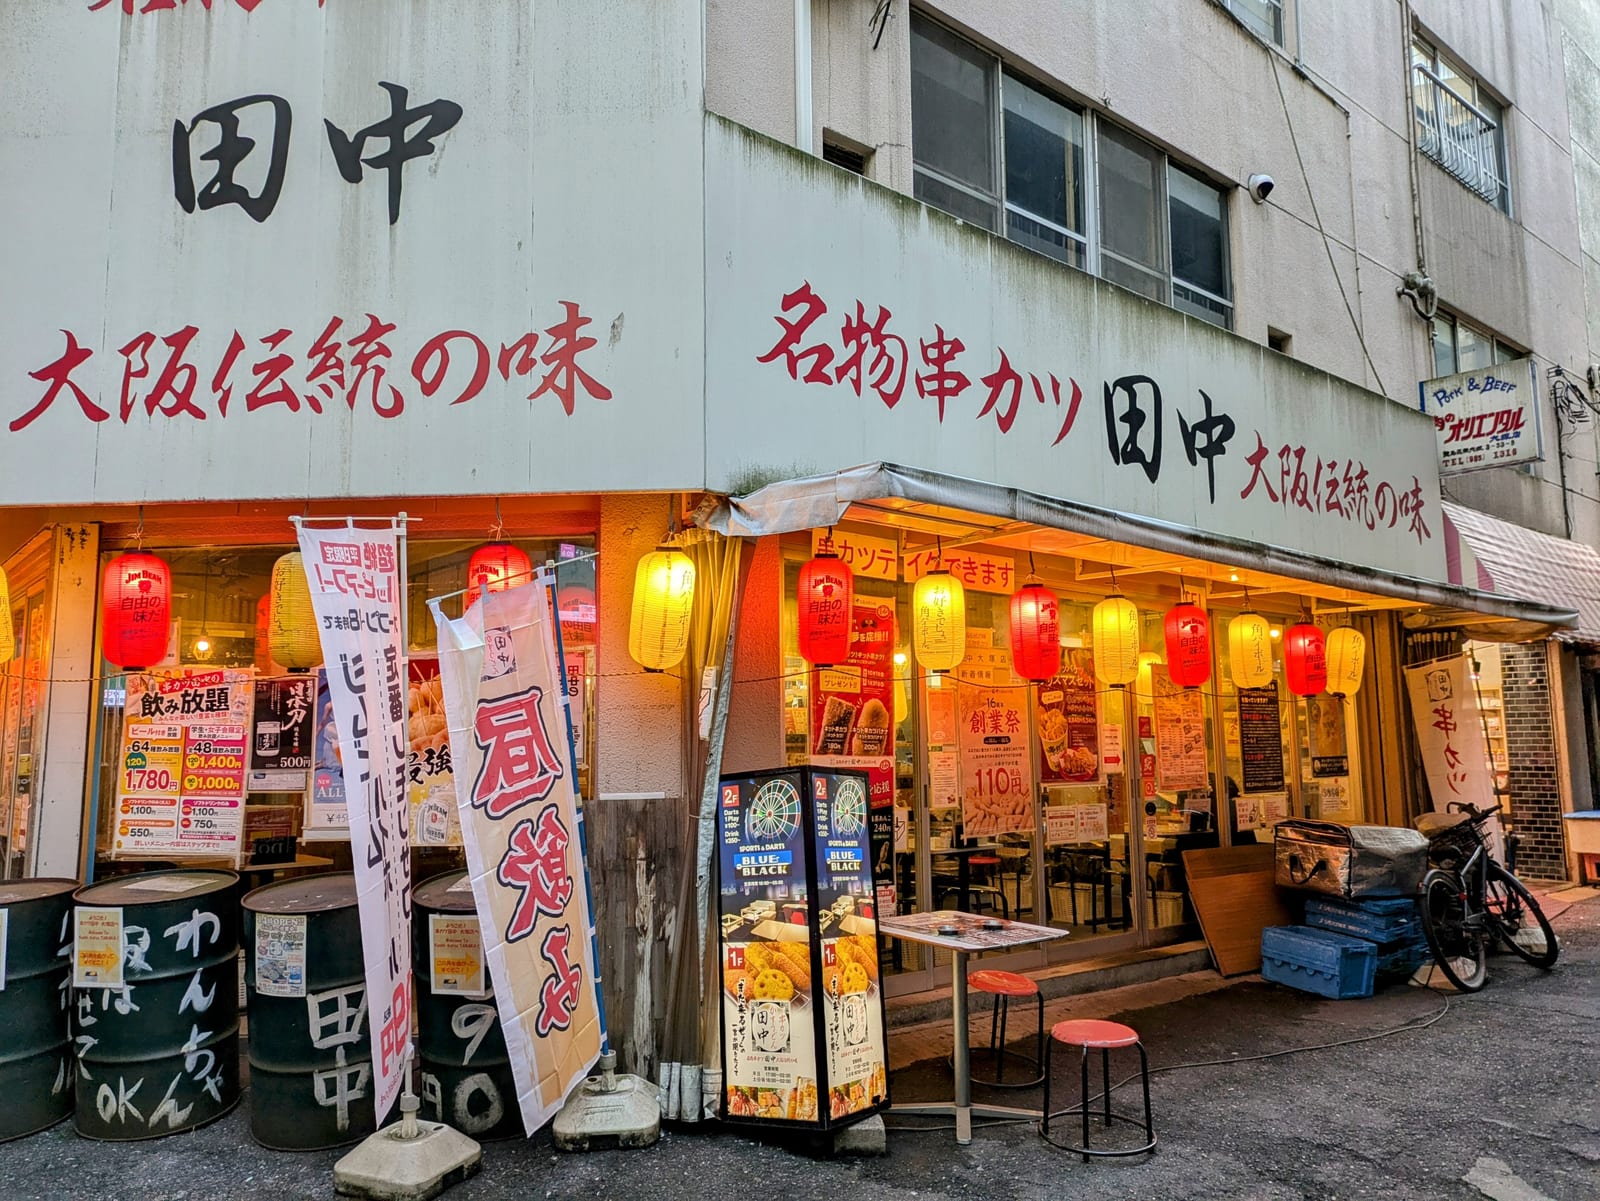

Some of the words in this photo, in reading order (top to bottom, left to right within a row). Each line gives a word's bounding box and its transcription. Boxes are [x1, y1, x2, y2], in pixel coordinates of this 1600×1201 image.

[172, 81, 463, 225] 田中
[9, 300, 612, 432] 大阪伝統の味
[1468, 377, 1480, 392] &
[756, 279, 1083, 447] 名物串カツ
[1103, 373, 1235, 503] 田中
[1240, 429, 1431, 545] 大阪伝統の味
[1444, 407, 1528, 444] オリエンタル
[1443, 459, 1464, 467] TEL
[812, 577, 825, 589] JIM
[825, 574, 843, 588] BEAM
[121, 596, 161, 611] 自由の
[809, 599, 842, 613] 自由の
[1251, 623, 1265, 674] 角ハイボール
[162, 675, 220, 692] 串カツ田中の
[568, 665, 580, 697] 田中の
[141, 687, 229, 717] 飲み放題
[970, 709, 1021, 735] 創業祭
[200, 756, 241, 768] 1,400円
[280, 757, 311, 768] 500円
[125, 769, 178, 791] 1,780円
[198, 777, 240, 790] 1,000円
[975, 768, 1022, 797] 110円
[724, 788, 738, 804] 2F
[816, 781, 827, 796] 2F
[130, 806, 156, 815] 1,100円
[192, 808, 219, 816] 1,100円
[194, 820, 217, 829] 750円
[129, 828, 154, 837] 550円
[765, 842, 785, 851] DARTS
[742, 854, 779, 865] BLUE
[830, 850, 855, 860] BLUE
[742, 866, 787, 876] BLACK
[831, 862, 860, 871] BLACK
[729, 950, 744, 967] 1F
[825, 948, 836, 963] 1F
[757, 1010, 769, 1044] 田中
[846, 1004, 855, 1038] 田中
[306, 983, 373, 1132] 田中
[96, 1075, 145, 1125] OK
